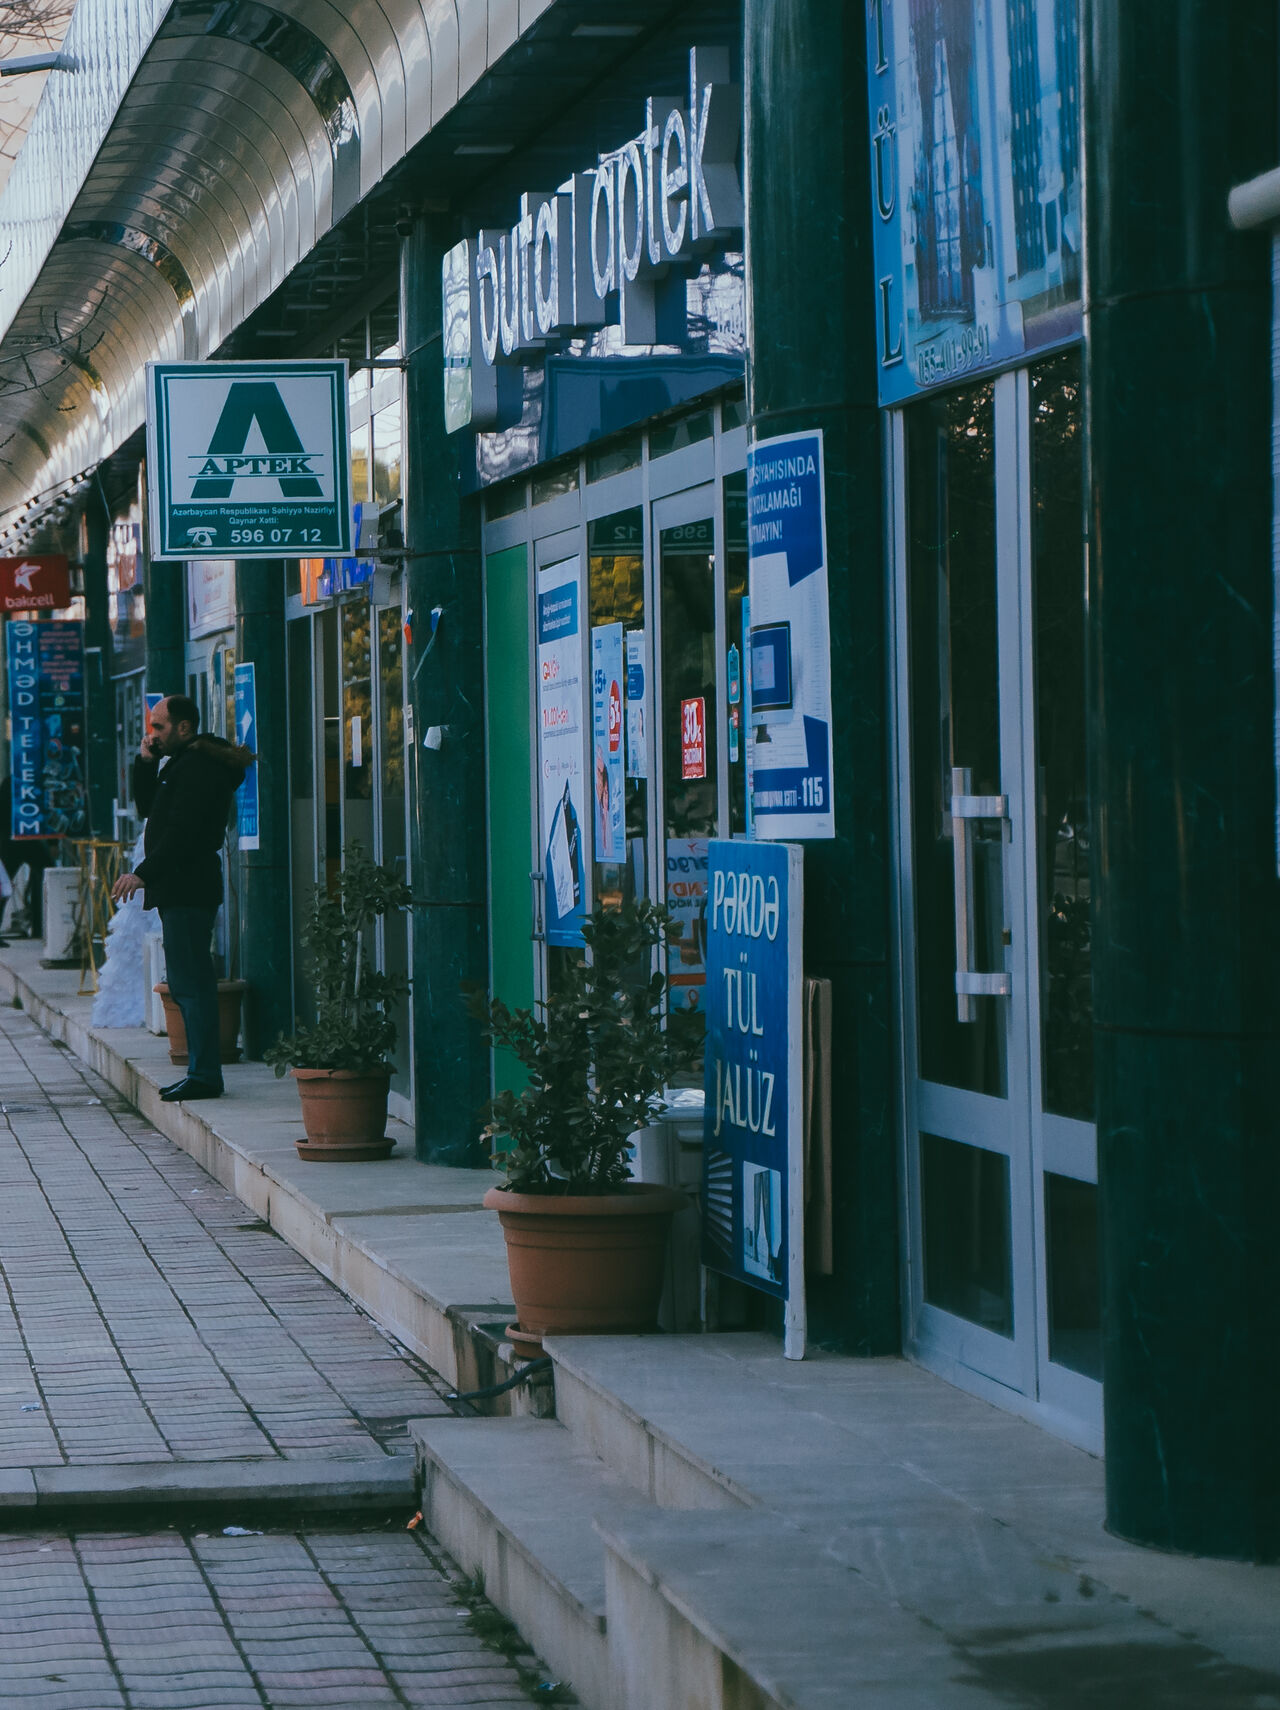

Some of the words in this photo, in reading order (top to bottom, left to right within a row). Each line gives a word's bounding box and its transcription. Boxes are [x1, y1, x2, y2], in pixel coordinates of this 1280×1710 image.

[590, 46, 716, 345] aptek
[198, 457, 314, 475] APTEK
[172, 508, 218, 517] Azərbaycan
[220, 507, 269, 516] Respublikası
[272, 507, 303, 515] Səhiyyə
[229, 517, 257, 526] Qaynar
[230, 529, 264, 543] 596
[270, 528, 293, 542] 07
[300, 528, 322, 542] 12
[5, 594, 55, 608] bakcell
[19, 716, 40, 834] TELEKOM
[802, 776, 824, 807] 115
[713, 870, 780, 941] PƏRDƏ
[723, 952, 764, 1036] TÜL
[713, 1050, 776, 1138] JALÜZ
